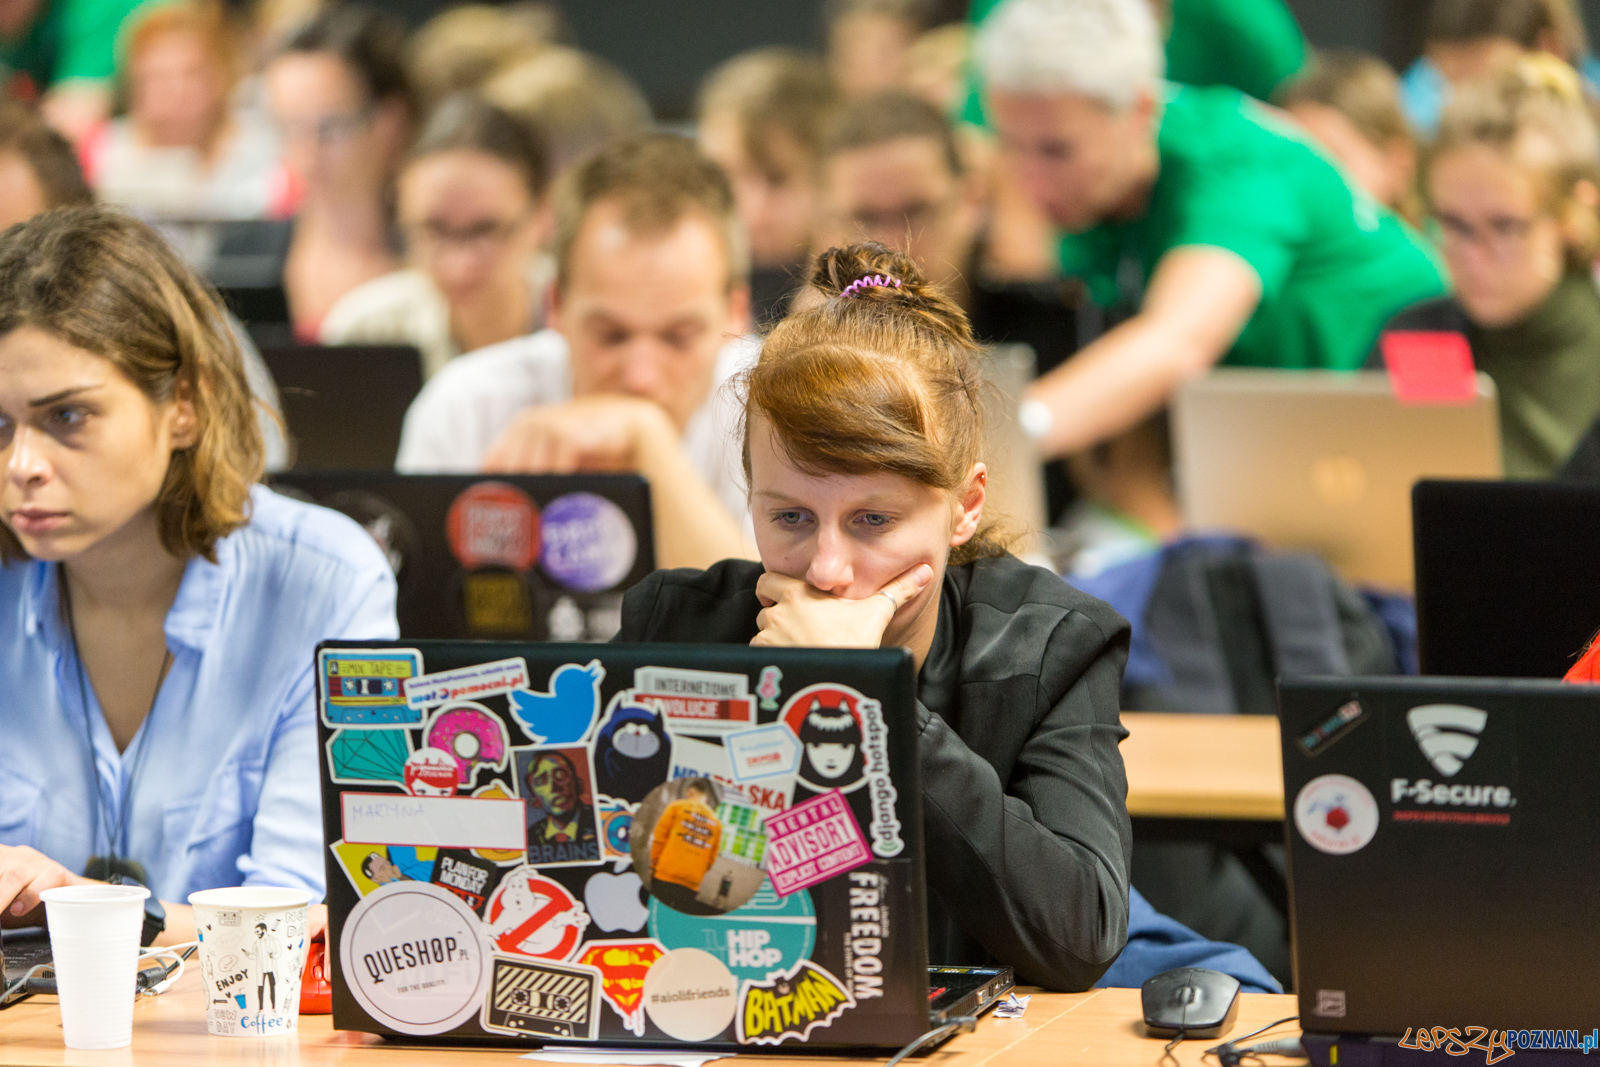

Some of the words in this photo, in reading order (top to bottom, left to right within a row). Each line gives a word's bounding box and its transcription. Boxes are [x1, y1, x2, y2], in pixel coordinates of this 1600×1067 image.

[348, 662, 363, 675] MIX
[370, 662, 393, 675] TAPE
[655, 678, 736, 697] INTERNETOWE
[863, 703, 884, 773] hotspot
[352, 803, 425, 820] MARTYNA
[767, 797, 840, 840] ARENTAL
[876, 777, 896, 841] django
[529, 842, 599, 863] BRAINS
[770, 815, 852, 872] ADVISORY
[441, 857, 468, 878] PLAN
[466, 866, 489, 884] FOR
[779, 861, 818, 885] EXPLICIT
[816, 846, 863, 871] CONTENT
[439, 870, 487, 895] MONDAY
[726, 929, 771, 949] HIP
[848, 871, 884, 999] FREEDOM
[728, 947, 783, 968] HOP
[215, 968, 249, 992] ENJOY
[397, 986, 409, 994] FOR
[409, 983, 420, 992] THE
[421, 979, 446, 990] QUALITY
[651, 986, 731, 1004] #aiolifriends
[745, 969, 847, 1037] BATMAN
[215, 1021, 236, 1034] DAY
[240, 1014, 284, 1035] Coffee
